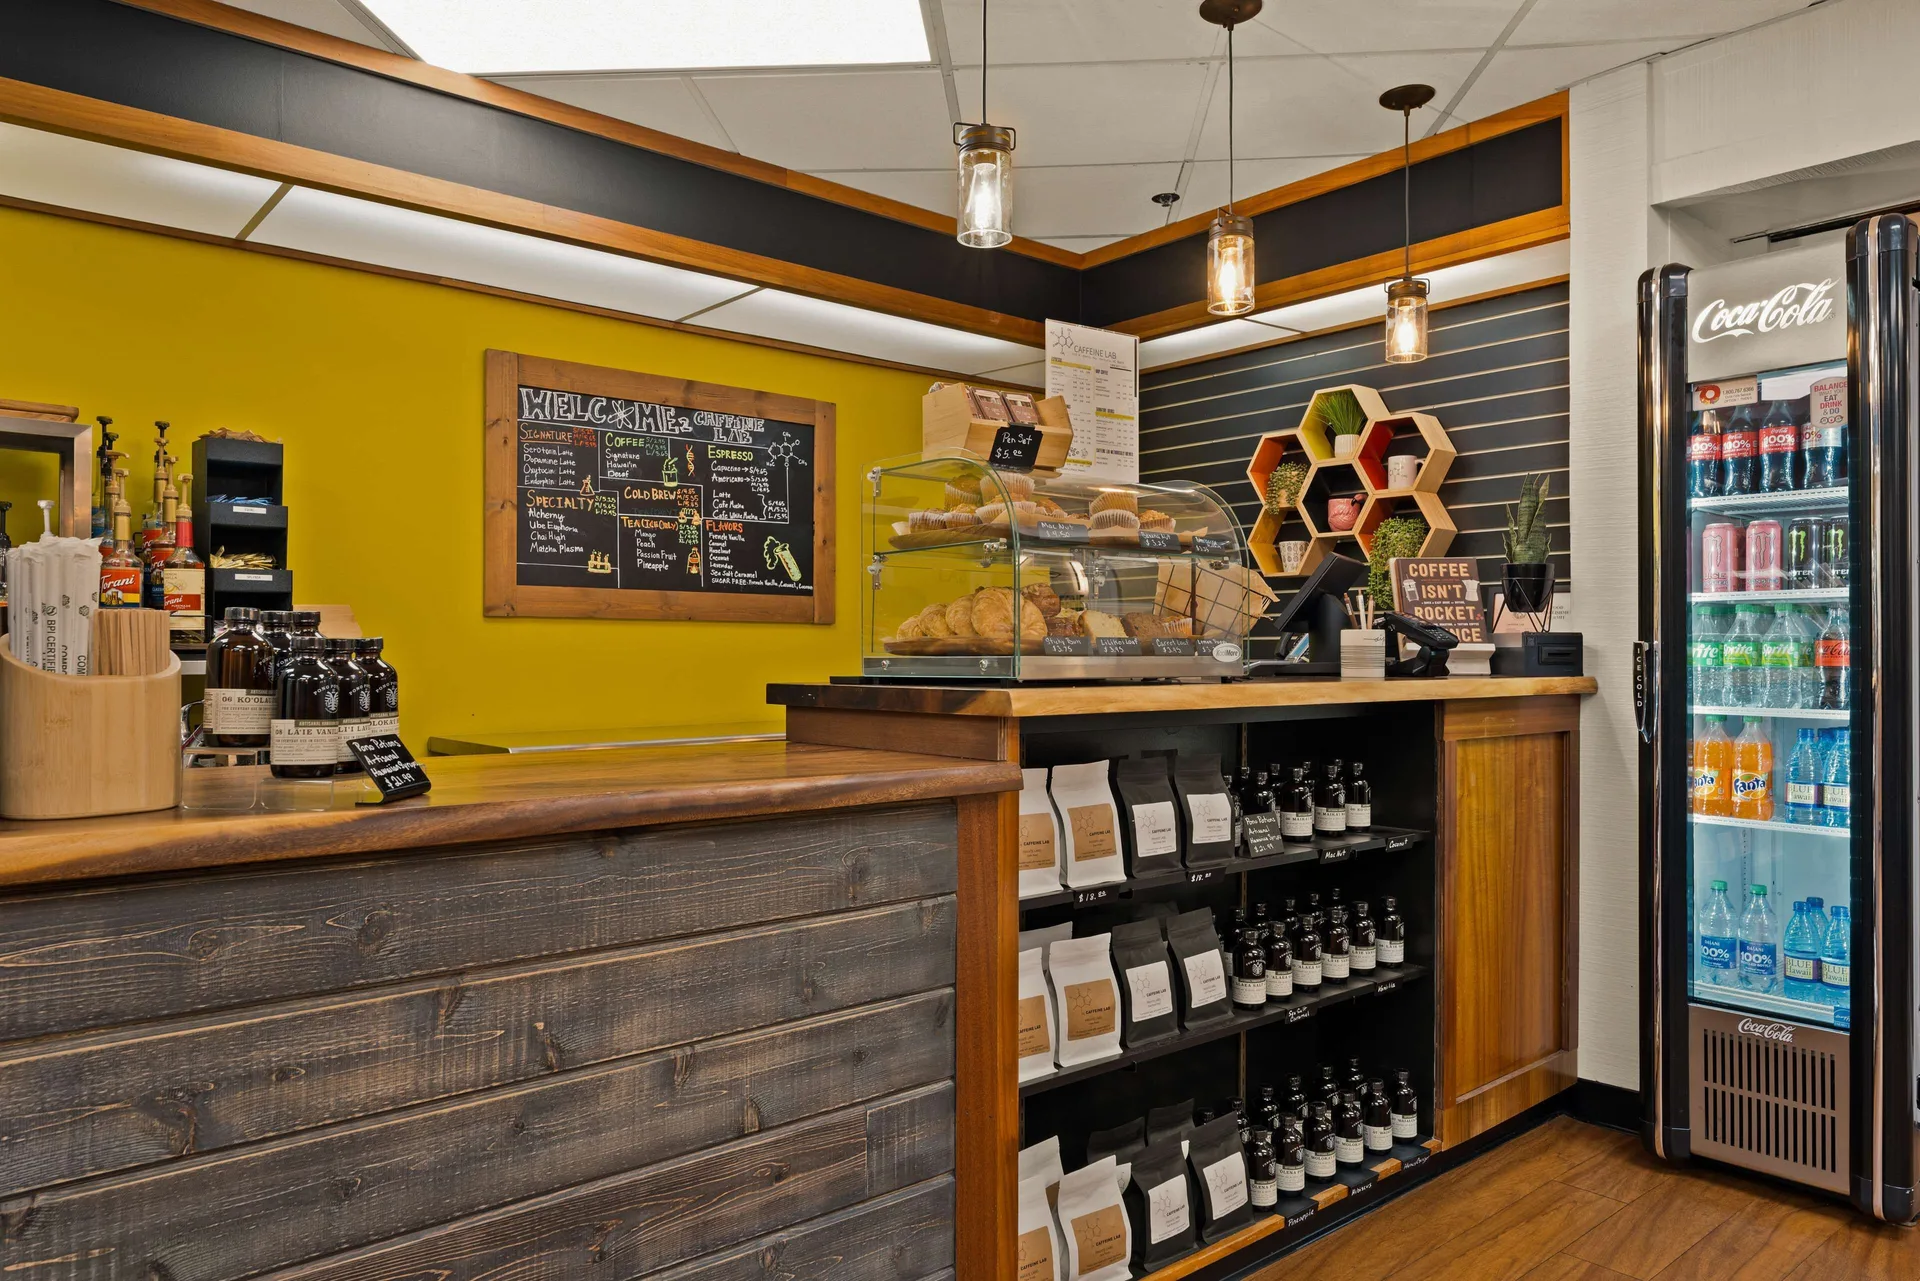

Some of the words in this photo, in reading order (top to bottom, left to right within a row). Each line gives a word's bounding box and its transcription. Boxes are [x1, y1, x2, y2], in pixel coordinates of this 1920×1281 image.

[1074, 345, 1103, 357] CAFFEINE
[1105, 351, 1116, 359] LAB
[1814, 381, 1847, 392] BALANCE
[1820, 400, 1842, 409] DRINK
[1824, 394, 1837, 402] EAT
[520, 423, 572, 442] SIGNATURE
[713, 427, 752, 443] LAB
[1002, 432, 1017, 444] Pen
[1017, 433, 1032, 445] Set
[606, 432, 645, 447] COFFEE
[558, 446, 573, 456] Latte
[606, 448, 640, 461] Signature
[708, 445, 753, 461] ESPRESSO
[560, 458, 576, 466] Latte
[559, 467, 575, 475] Latte
[559, 477, 575, 486] Latte
[624, 486, 650, 499] COLD
[651, 488, 675, 500] BREW
[713, 490, 731, 498] Latte
[526, 489, 594, 511] SPECIALTY
[528, 508, 565, 522] Alchemy
[547, 522, 578, 533] Euphoria
[706, 520, 743, 533] FLAVORS
[530, 531, 548, 541] Chai
[548, 532, 566, 544] High
[635, 529, 656, 541] Mango
[530, 543, 557, 553] Matcha
[559, 545, 583, 554] Plasma
[637, 538, 655, 548] Peach
[637, 549, 660, 559] Passion
[661, 550, 677, 560] Fruit
[637, 559, 669, 571] Pineapple
[1409, 563, 1470, 577] COFFEE
[101, 574, 135, 593] Torani
[1421, 585, 1462, 598] ISN'T
[1414, 606, 1476, 620] ROCKET
[47, 620, 56, 633] BPI
[1723, 643, 1753, 656] Sprite
[1762, 643, 1794, 657] Sprite
[352, 741, 374, 752] Pono
[373, 739, 401, 750] Potions
[365, 750, 399, 765] Artisanal
[385, 773, 415, 789] $21.99
[1694, 774, 1714, 786] anta
[1734, 778, 1766, 794] Fanta
[1741, 951, 1772, 964] 100%
[1786, 958, 1811, 968] BLUE
[1823, 963, 1847, 974] BLUE
[1738, 1017, 1796, 1043] Coca-Cola
[1095, 1237, 1111, 1247] CAFFEINE
[1020, 1260, 1036, 1271] CAFFEINE
